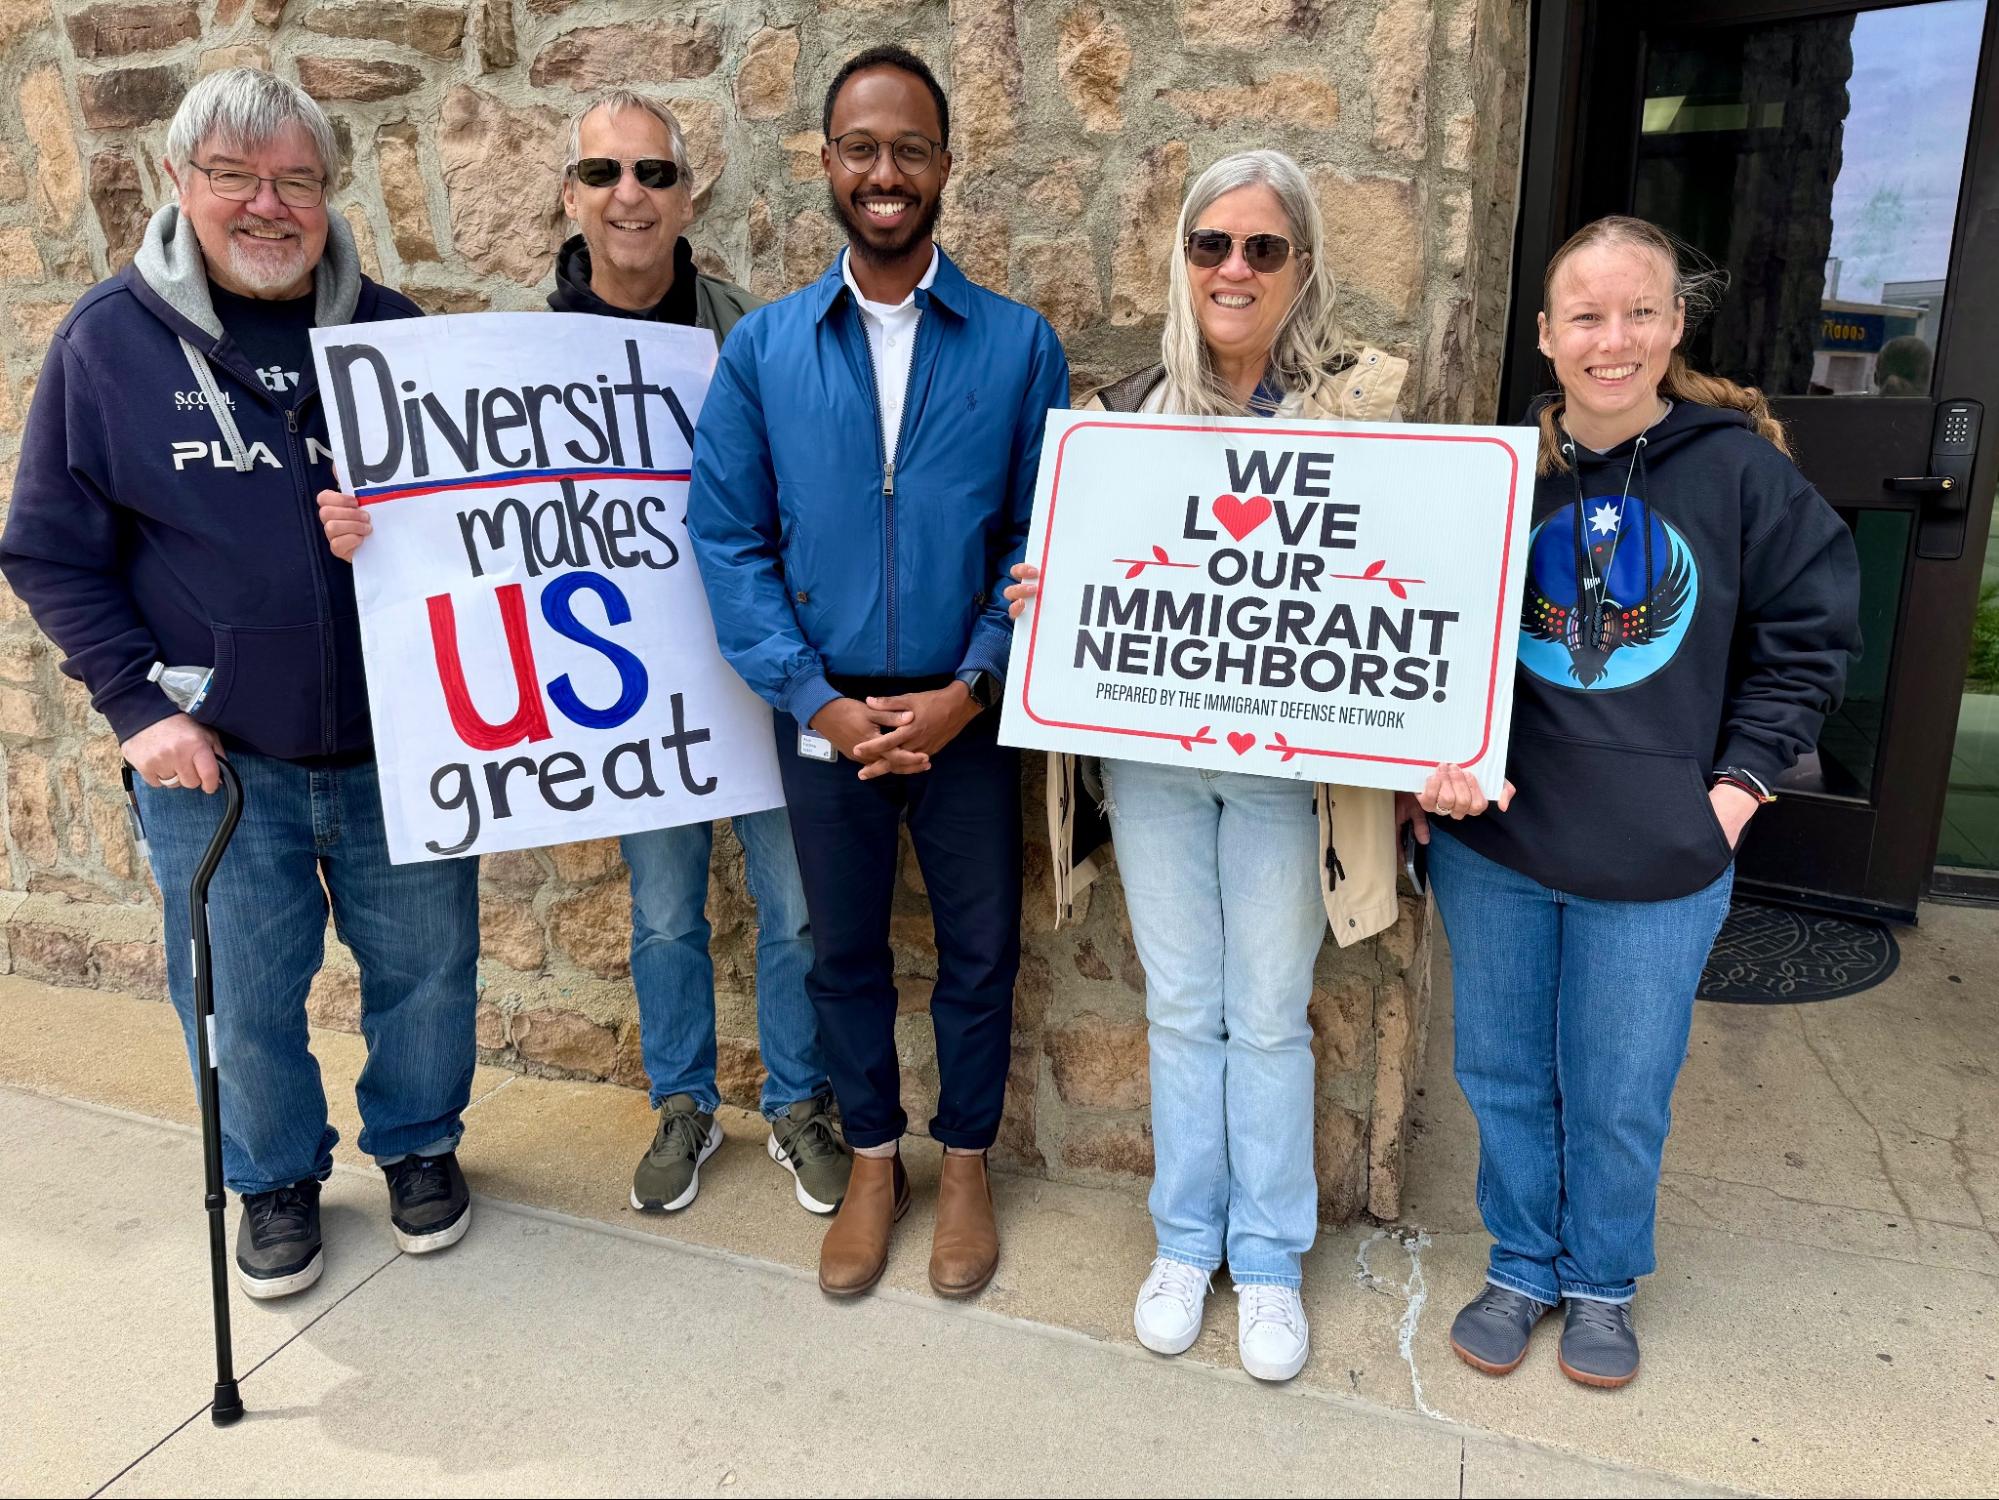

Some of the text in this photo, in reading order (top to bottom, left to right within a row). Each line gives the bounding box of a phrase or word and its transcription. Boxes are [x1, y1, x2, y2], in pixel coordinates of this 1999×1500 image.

[1225, 448, 1335, 498] WE
[457, 478, 680, 577] makes
[1182, 494, 1360, 549] LVE
[1207, 547, 1326, 592] OUR
[1079, 584, 1460, 656] IMMIGRANT
[1073, 629, 1450, 703] NEIGHBORS!
[1096, 682, 1406, 729] PREPARED BY THE IMMIGRANT DEFENSE NETWORK
[425, 693, 718, 855] great
